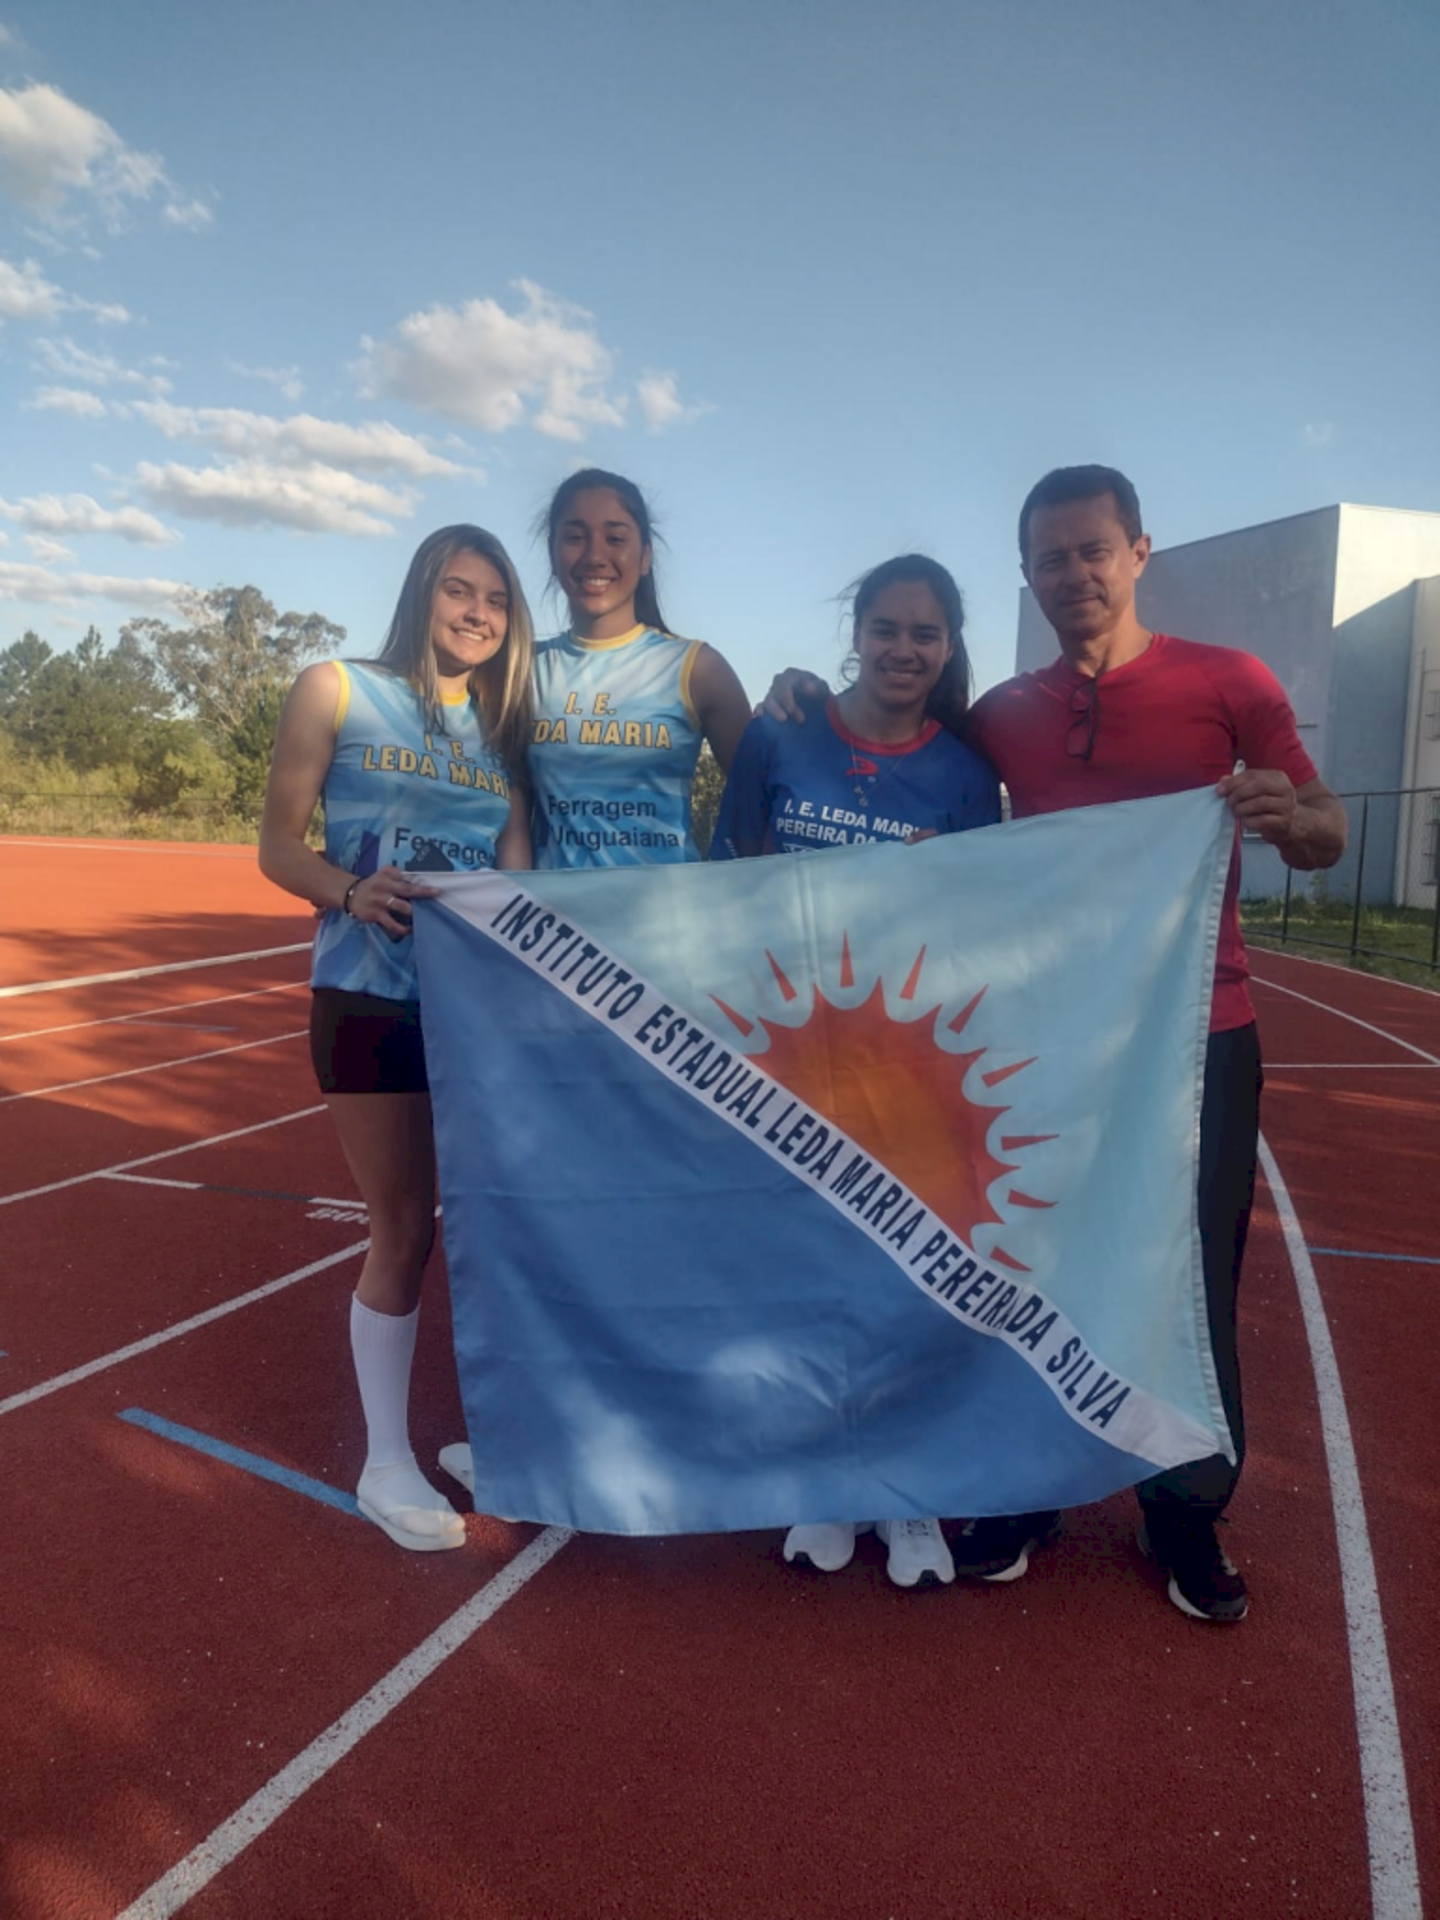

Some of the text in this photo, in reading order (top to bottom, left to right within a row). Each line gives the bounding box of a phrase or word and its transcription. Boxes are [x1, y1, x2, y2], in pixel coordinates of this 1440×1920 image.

[565, 691, 617, 715] I. E.
[533, 718, 672, 750] DA MARIA
[362, 744, 511, 800] LEDA MARI
[547, 794, 657, 821] Ferragem
[799, 802, 815, 817] E.
[821, 805, 867, 829] LEDA
[872, 816, 920, 839] MAR
[549, 825, 680, 852] Uruguaiana
[776, 817, 847, 845] PEREIRA
[490, 893, 645, 1021] INSTITUTO
[634, 1003, 778, 1129] ESTADUAL
[764, 1101, 845, 1181] LEDA
[829, 1154, 927, 1251] MARIA
[1004, 1293, 1059, 1351] DA
[1046, 1336, 1132, 1430] SILVA
